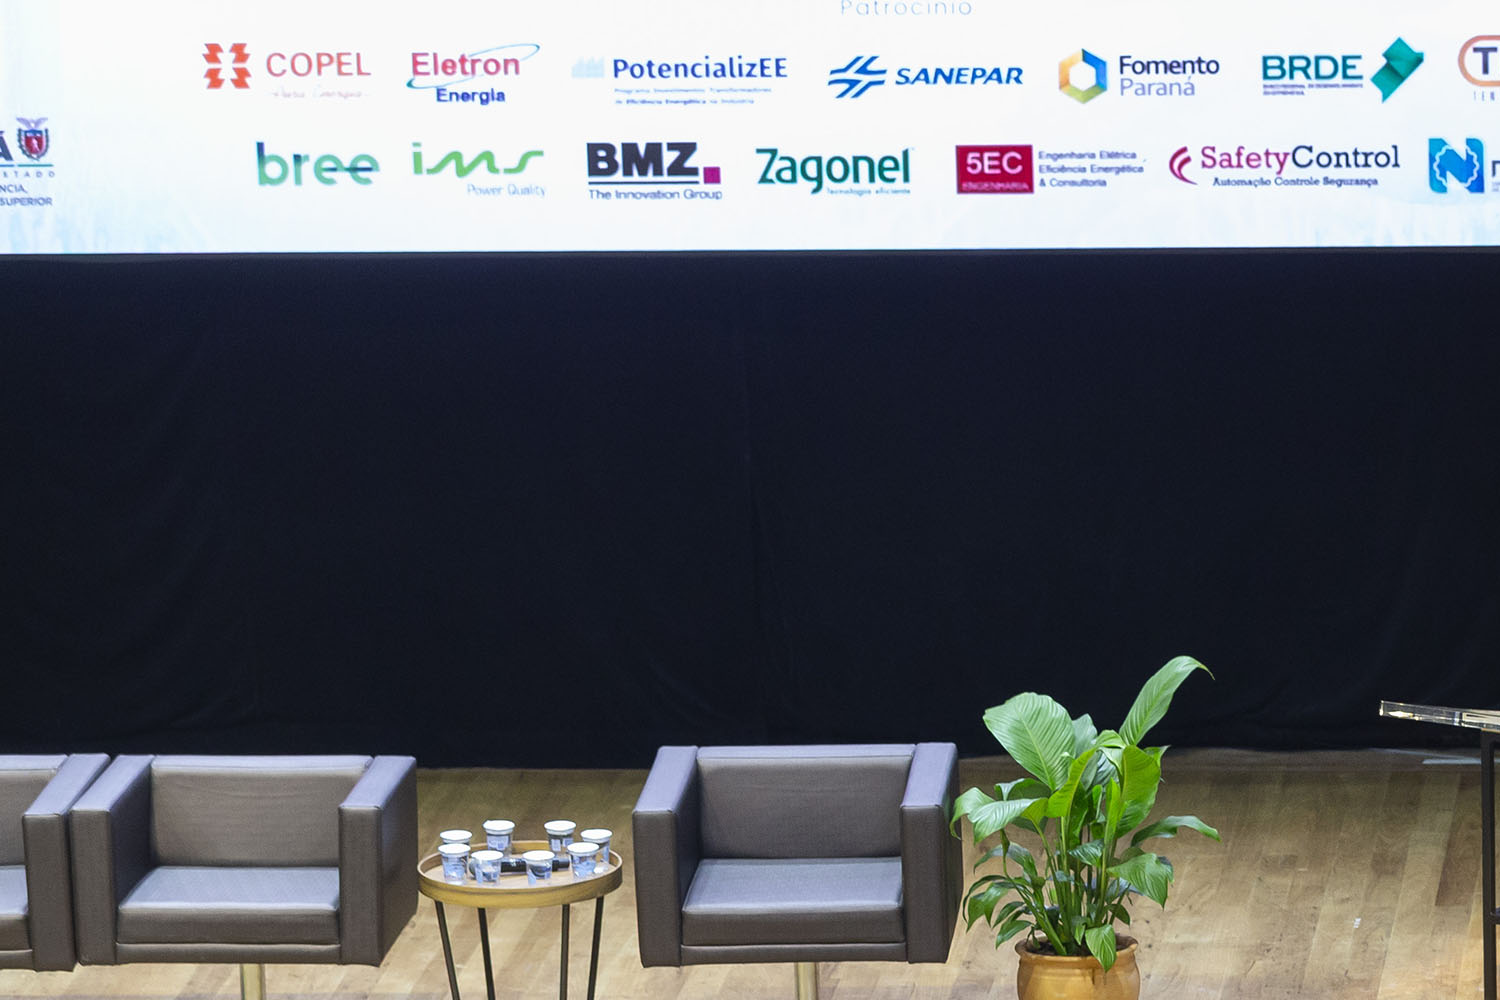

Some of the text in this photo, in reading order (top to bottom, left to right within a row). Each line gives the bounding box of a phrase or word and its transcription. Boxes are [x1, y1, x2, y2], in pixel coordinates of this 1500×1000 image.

[266, 52, 371, 77] COPEL
[412, 53, 519, 76] Eletron
[613, 55, 788, 79] PotencializEE
[1119, 55, 1220, 77] Fomento
[1262, 54, 1364, 81] BRDE
[895, 67, 1023, 85] SANEPAR
[1120, 76, 1195, 96] Paraná
[256, 141, 380, 186] bree
[965, 151, 1024, 175] 5EC
[1038, 150, 1137, 162] Engenharia Elétrica
[1201, 144, 1400, 175] SafetyControl
[755, 148, 911, 194] Zagonel
[1039, 164, 1144, 176] Eficiência Energética
[1212, 174, 1379, 188] Automação Controle Segurança
[467, 183, 546, 198] Power Quality
[1049, 178, 1107, 187] Consultoria
[589, 189, 722, 200] The Innovation Group
